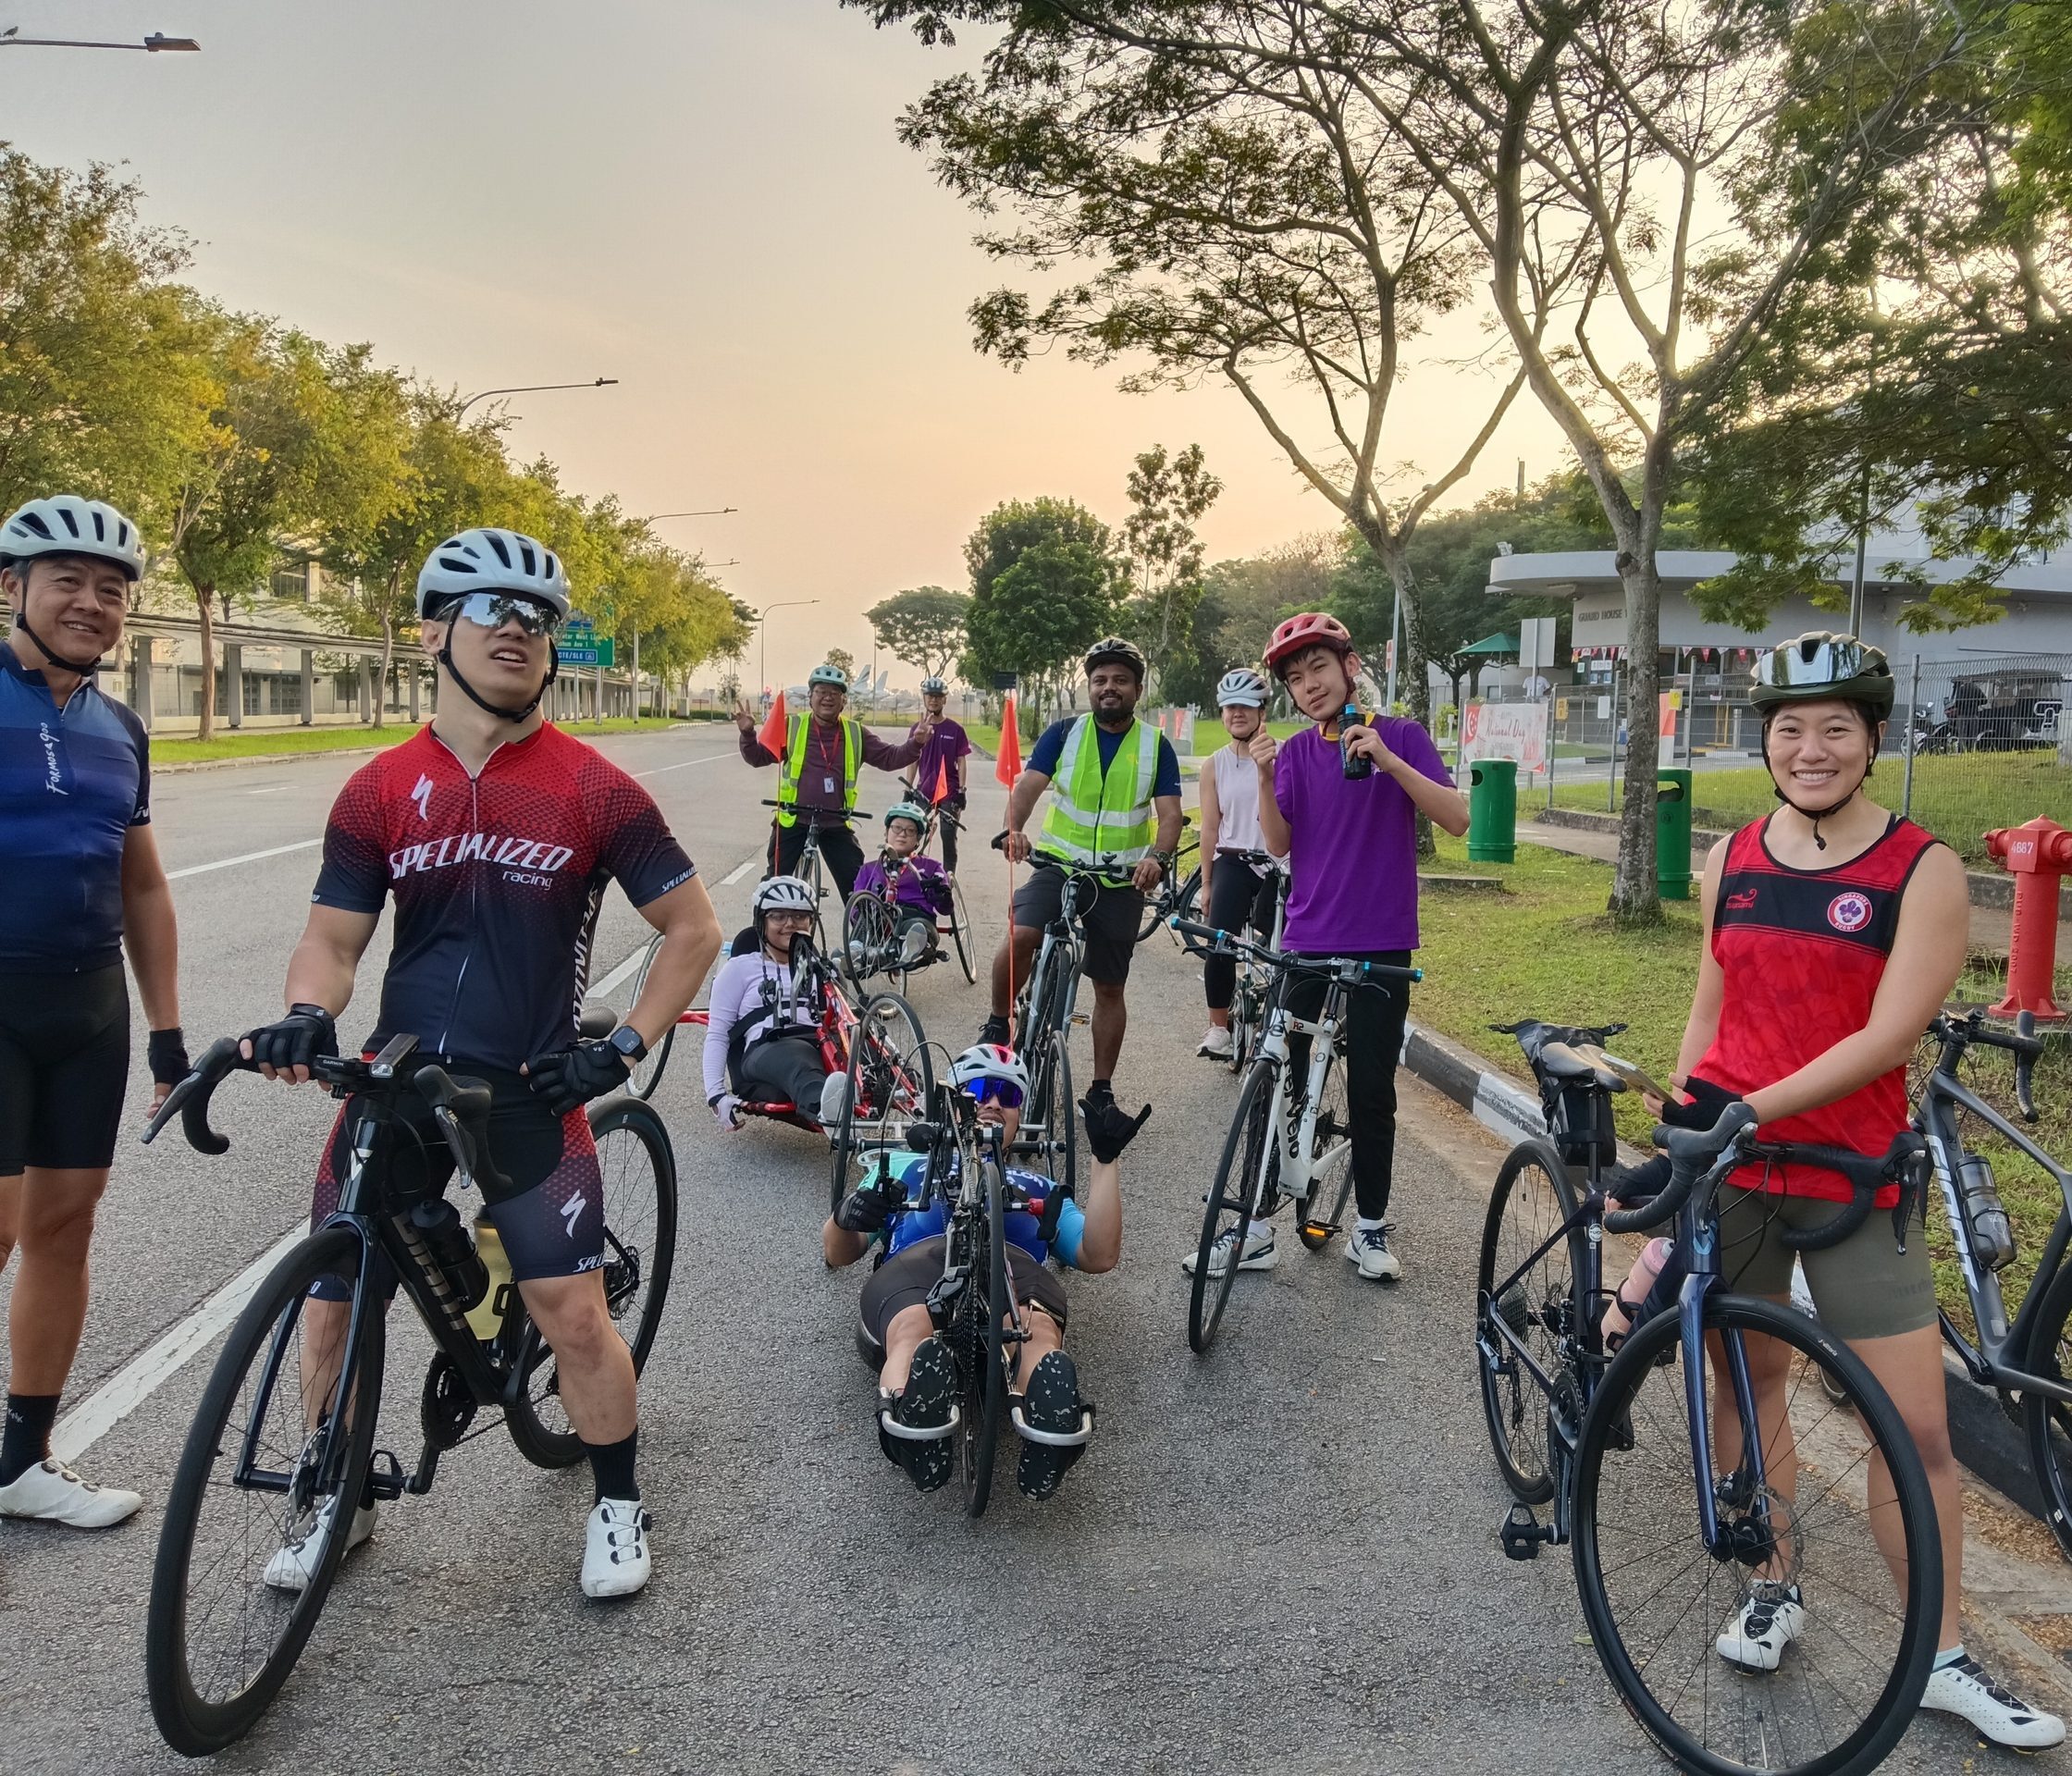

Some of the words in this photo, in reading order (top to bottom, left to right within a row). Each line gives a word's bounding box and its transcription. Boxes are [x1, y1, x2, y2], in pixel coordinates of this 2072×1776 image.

[1578, 611, 1600, 623] GUARD
[1601, 609, 1622, 621] HOUSE
[558, 651, 584, 660] CTE/SLE
[1512, 719, 1525, 745] Day
[388, 832, 574, 880] SPECIALIZED
[2011, 841, 2034, 855] 4887
[502, 871, 553, 891] racing
[1838, 894, 1868, 906] SINGAPORE
[1923, 1134, 1980, 1293] GIANT
